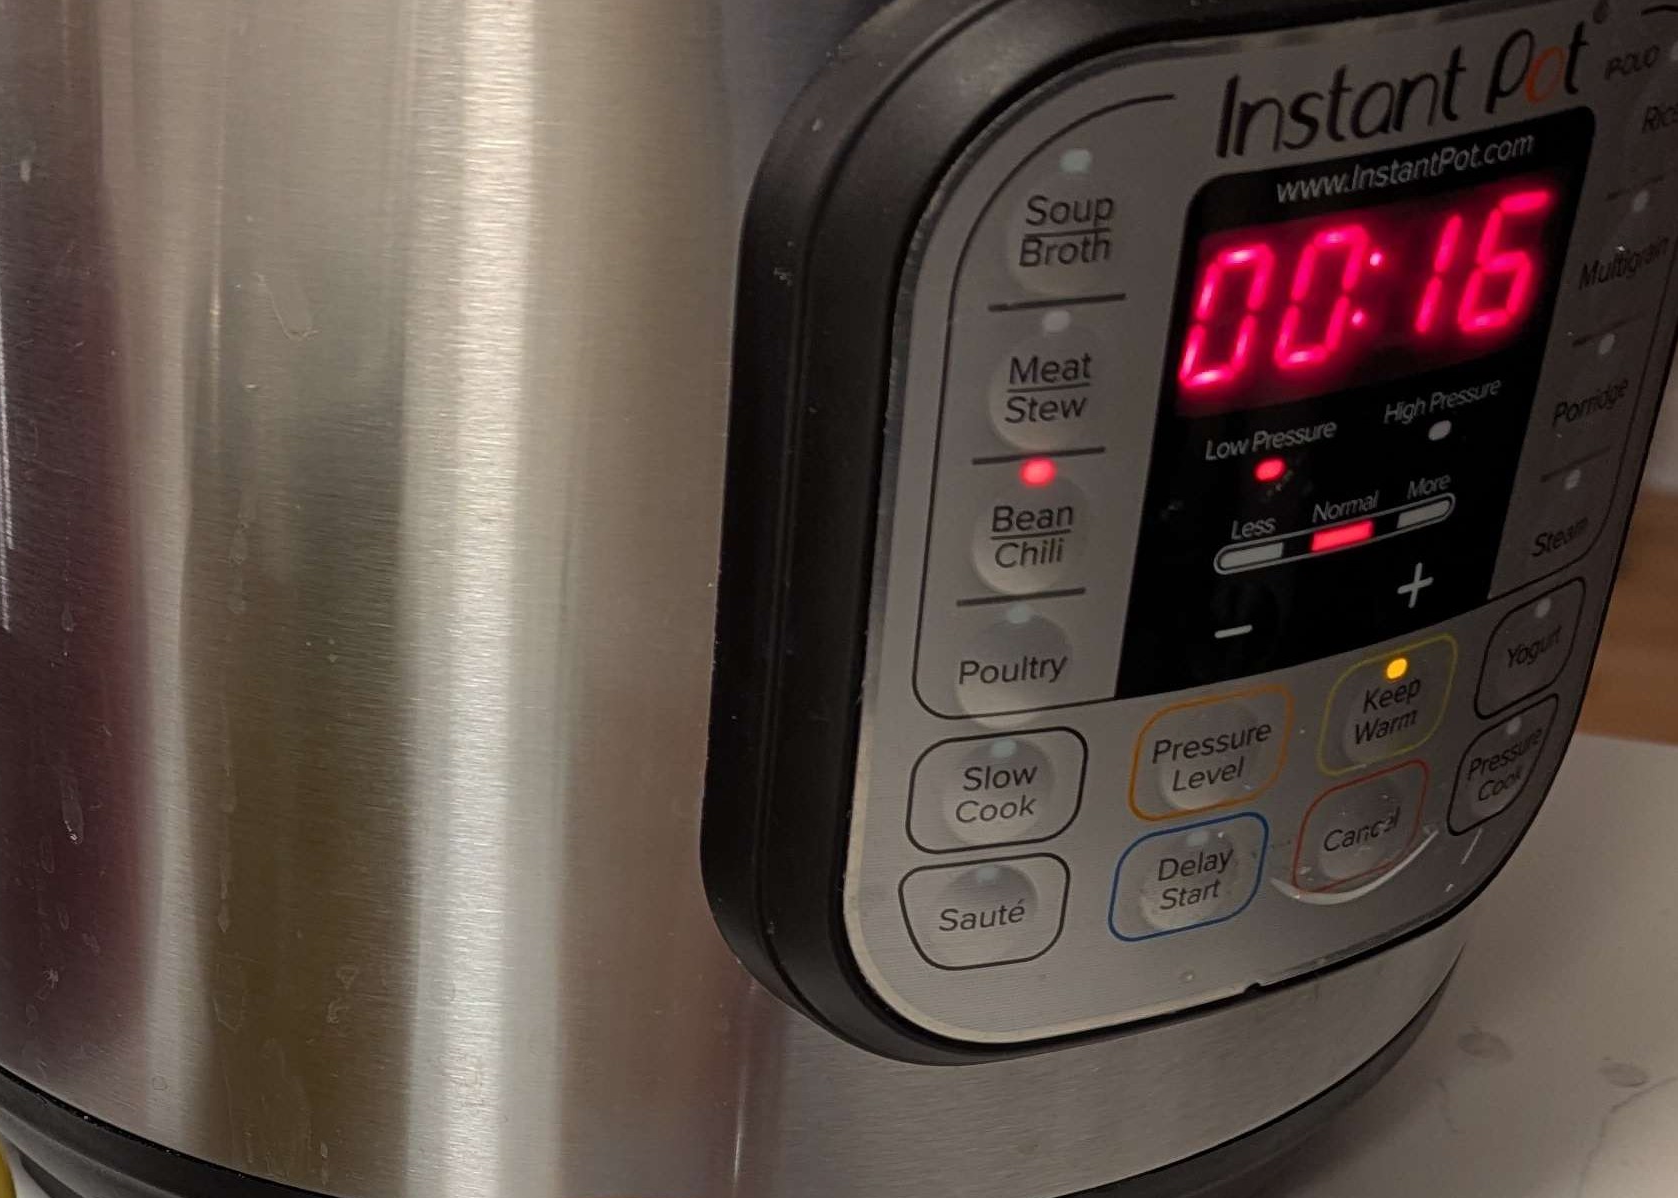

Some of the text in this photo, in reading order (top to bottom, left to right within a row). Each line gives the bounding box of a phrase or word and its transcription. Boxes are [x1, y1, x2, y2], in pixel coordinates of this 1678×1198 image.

[1215, 20, 1588, 158] Instant Pot
[1275, 133, 1534, 204] www.InstantPot.com
[1024, 195, 1114, 229] Soup
[1018, 230, 1112, 268] Broth
[1179, 189, 1552, 390] 00:16
[1008, 353, 1092, 386] Meat
[1004, 394, 1087, 425] Stew
[1384, 376, 1502, 426] High Pressure
[1205, 418, 1338, 463] Low Pressure
[1406, 472, 1451, 501] More
[991, 503, 1075, 533] Bean
[1312, 491, 1380, 524] Normal
[1231, 514, 1276, 541] Less
[1532, 516, 1589, 557] Steam
[994, 537, 1065, 569] Chili
[1507, 624, 1562, 670] Yogurt
[958, 651, 1068, 688] Poultry
[1362, 676, 1423, 714] Keep
[1152, 719, 1273, 766] Pressure
[1353, 706, 1418, 746] Warm
[1467, 727, 1543, 782] Pressure
[963, 762, 1038, 791] Slow
[1171, 756, 1246, 793] Level
[1477, 771, 1523, 802] Cook
[955, 793, 1035, 824] Cook
[1323, 807, 1401, 853] Cancel
[1157, 846, 1235, 883] Delay
[1159, 879, 1221, 911] Start
[938, 898, 1026, 932] Sauté
